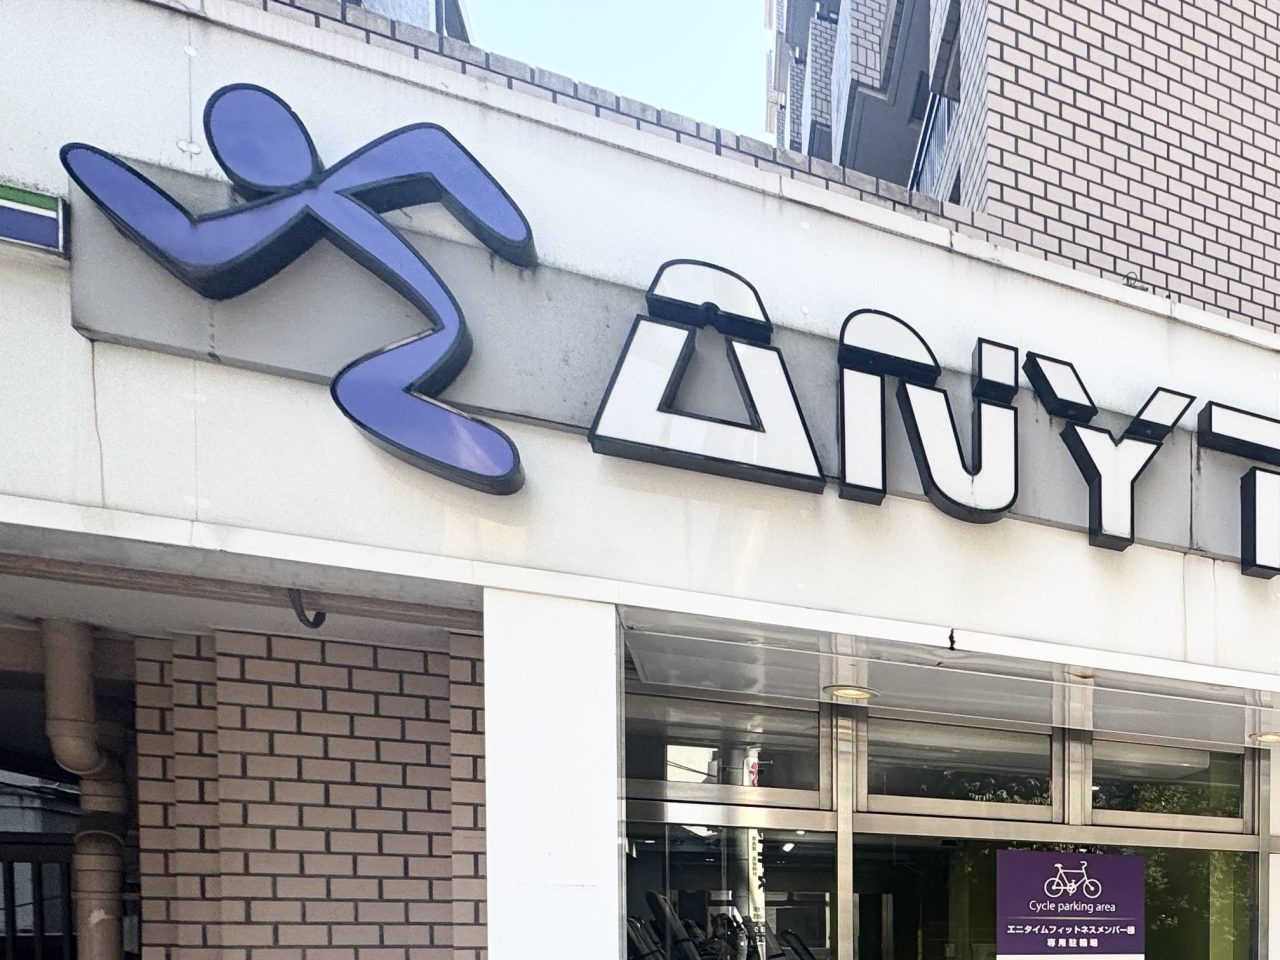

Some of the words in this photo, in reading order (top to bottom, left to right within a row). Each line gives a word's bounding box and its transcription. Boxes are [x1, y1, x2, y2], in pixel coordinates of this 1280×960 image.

[1029, 900, 1056, 913] Cycle
[1057, 901, 1094, 913] parking
[1095, 903, 1117, 912] area
